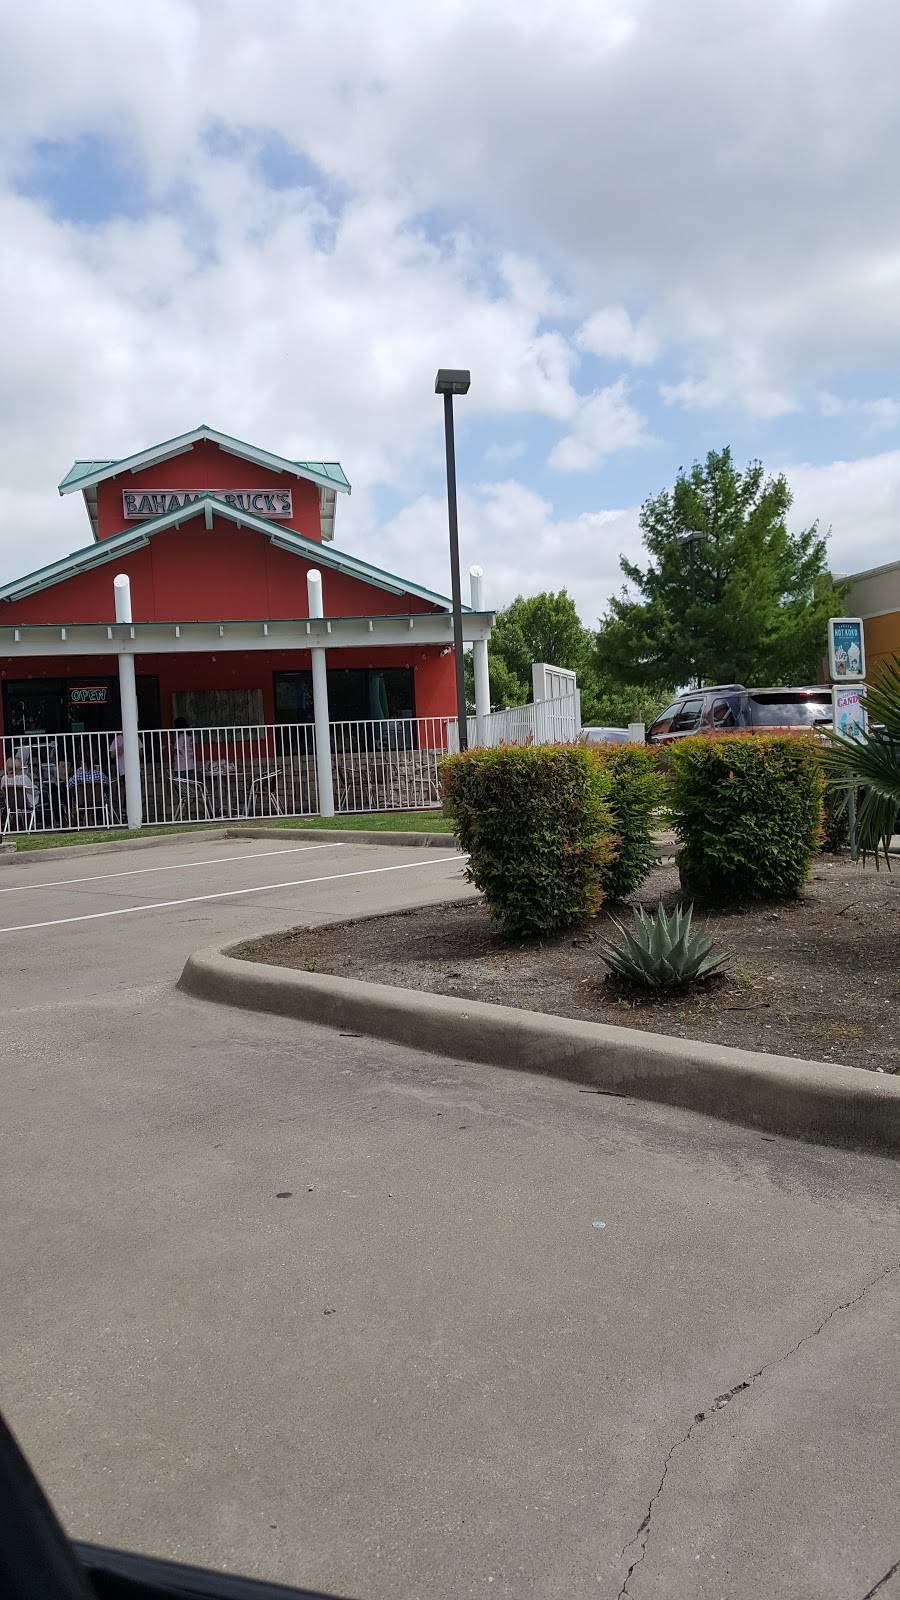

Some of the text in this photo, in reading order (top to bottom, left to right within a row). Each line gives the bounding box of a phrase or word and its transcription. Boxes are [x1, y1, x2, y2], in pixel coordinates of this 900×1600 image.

[124, 494, 200, 512] BAHAM
[71, 688, 107, 702] OPEN
[837, 695, 859, 707] CAND
